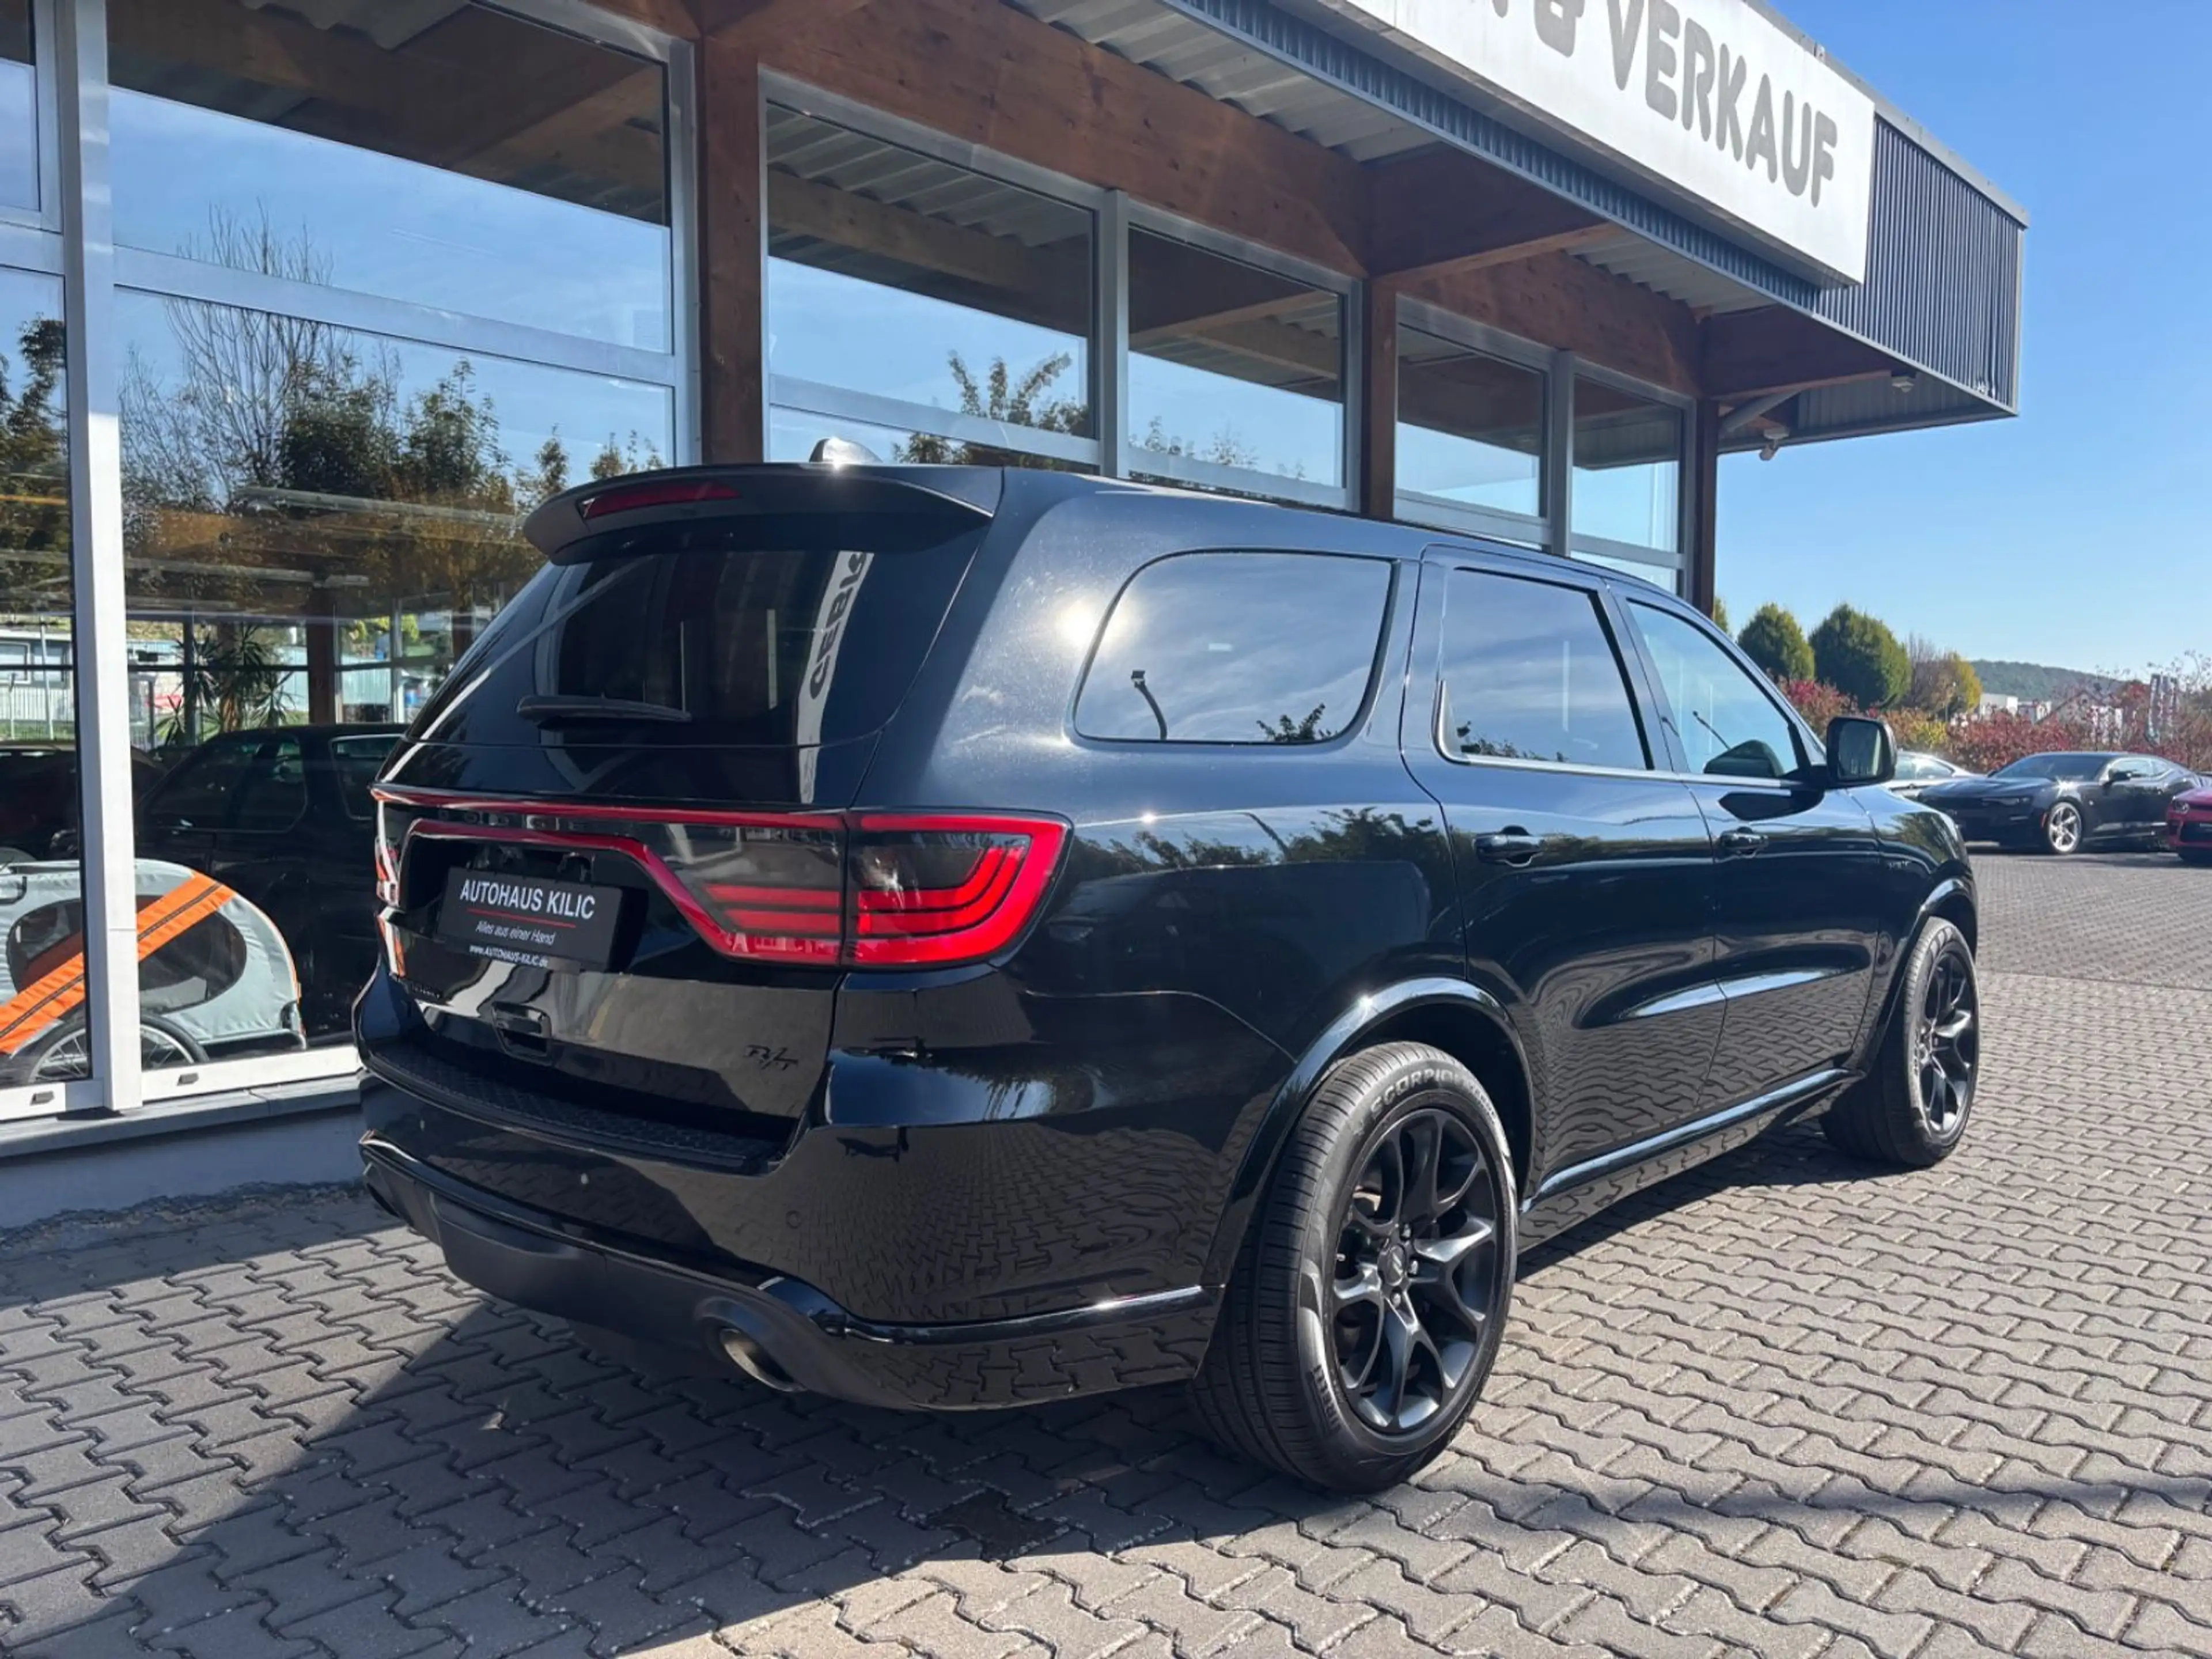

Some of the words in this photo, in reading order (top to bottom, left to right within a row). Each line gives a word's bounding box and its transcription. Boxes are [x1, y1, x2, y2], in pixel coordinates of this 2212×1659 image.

[1607, 0, 1838, 208] VERKAUF
[460, 878, 543, 912] AUTOHAUS
[546, 890, 596, 920] KILIC
[475, 921, 494, 934] Alles
[494, 926, 509, 938] aus
[509, 926, 531, 941] einer
[530, 929, 557, 946] Hand
[743, 1044, 799, 1071] R/T
